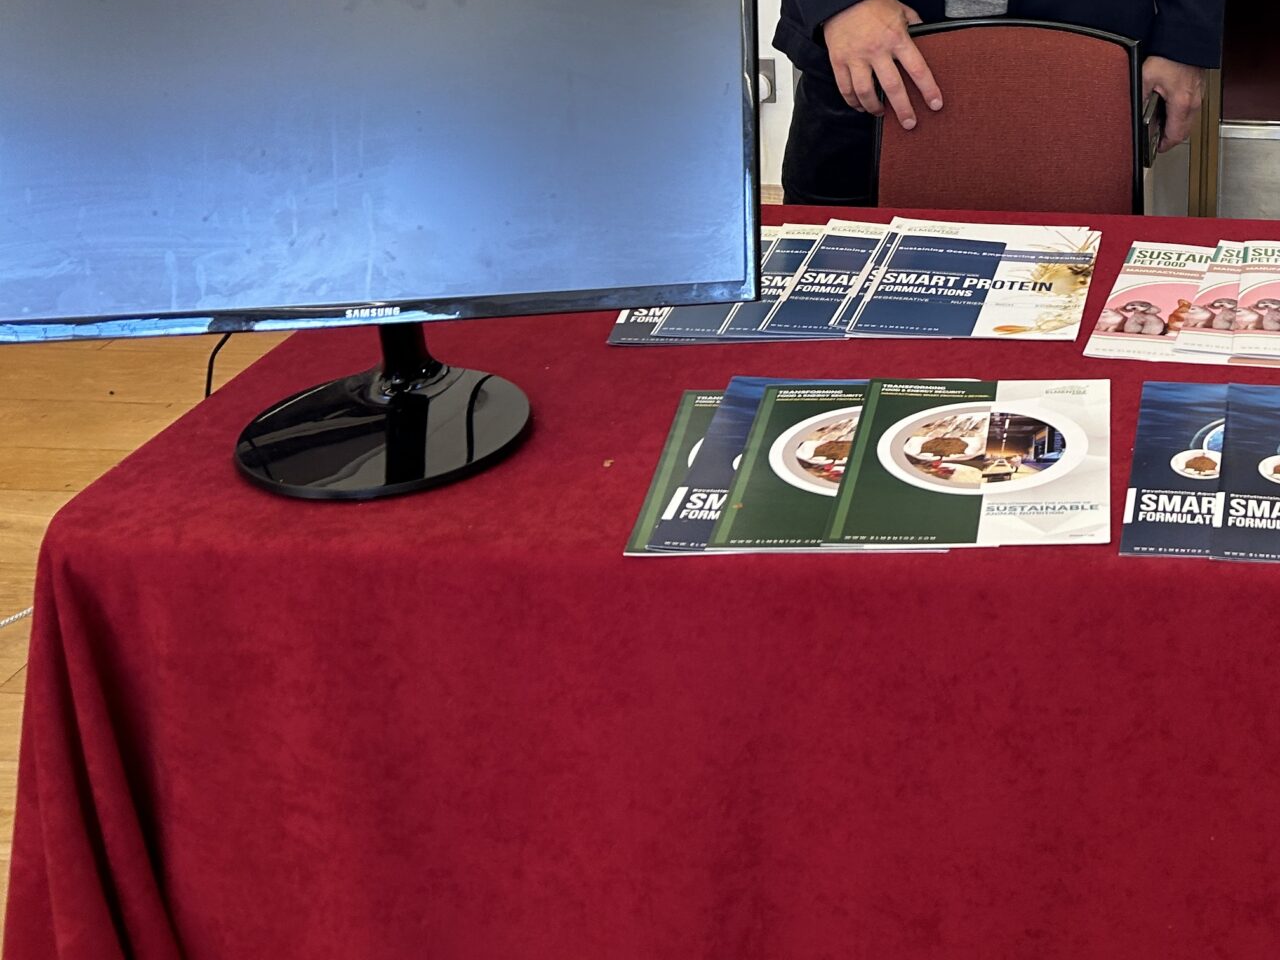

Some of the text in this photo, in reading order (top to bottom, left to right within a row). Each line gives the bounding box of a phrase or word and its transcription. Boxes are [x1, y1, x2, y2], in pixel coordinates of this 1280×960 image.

[1133, 258, 1156, 266] PET
[1136, 250, 1213, 264] SUSTAIN
[800, 272, 859, 286] SMA
[882, 272, 960, 287] SMART
[963, 278, 1053, 292] PROTEIN
[795, 285, 850, 294] FORMUL
[878, 284, 973, 297] FORMULATIONS
[345, 307, 400, 318] SAMSUNG
[986, 504, 1100, 512] SUSTAINABLE
[1140, 494, 1216, 514] SMAR
[1138, 511, 1214, 524] FORMULAT
[1133, 546, 1210, 554] WWW.ELMENTOZ.C
[1224, 551, 1280, 559] WWW.ELMENT
